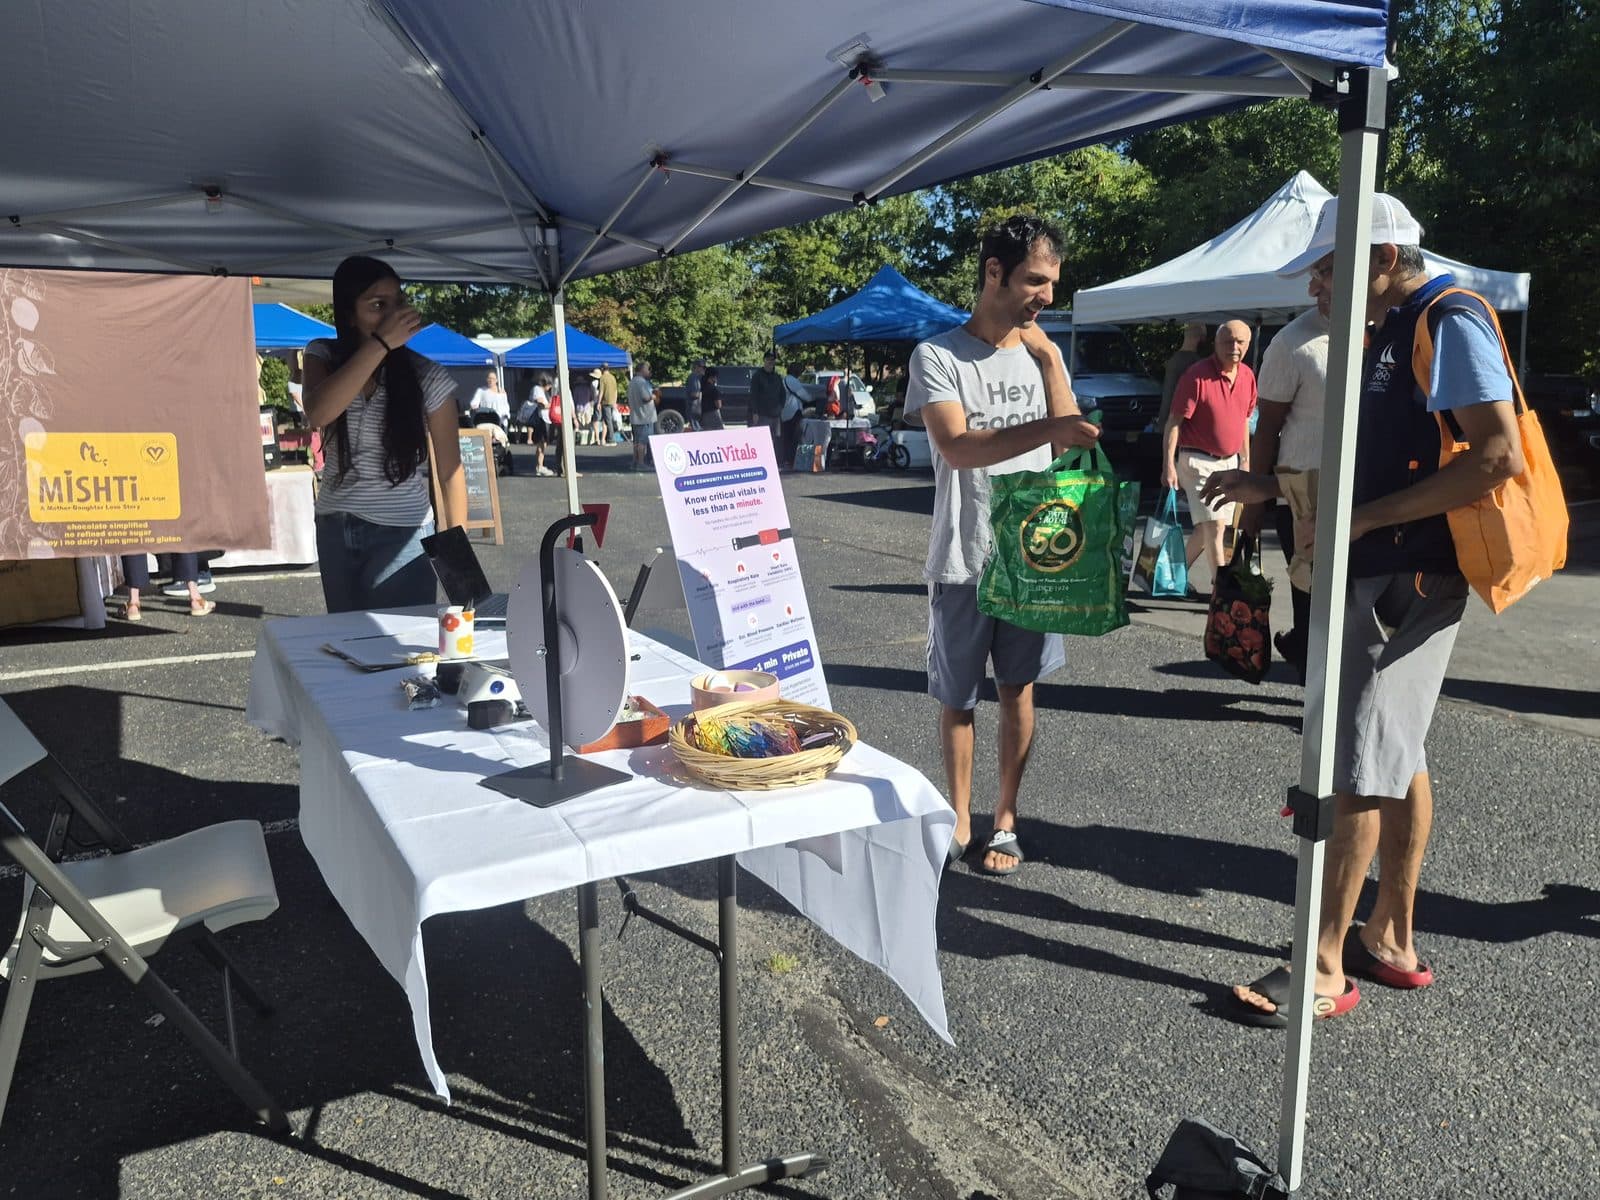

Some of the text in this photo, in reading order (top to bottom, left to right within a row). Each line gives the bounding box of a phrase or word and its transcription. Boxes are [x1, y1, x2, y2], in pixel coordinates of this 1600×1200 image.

[986, 381, 1036, 407] Hey
[965, 404, 1049, 431] Gool
[687, 442, 758, 467] MoniVitals
[683, 479, 697, 487] FREE
[696, 476, 723, 485] COMMUNITY
[684, 486, 766, 506] Know critical vitals in
[692, 498, 764, 516] less than a minute.
[66, 521, 149, 530] chocolate simplified
[76, 530, 106, 538] refined
[129, 529, 152, 537] sugar
[77, 539, 98, 547] dairy
[156, 535, 182, 545] gluten
[1029, 526, 1078, 555] 50
[763, 657, 779, 670] min
[781, 647, 809, 664] Private
